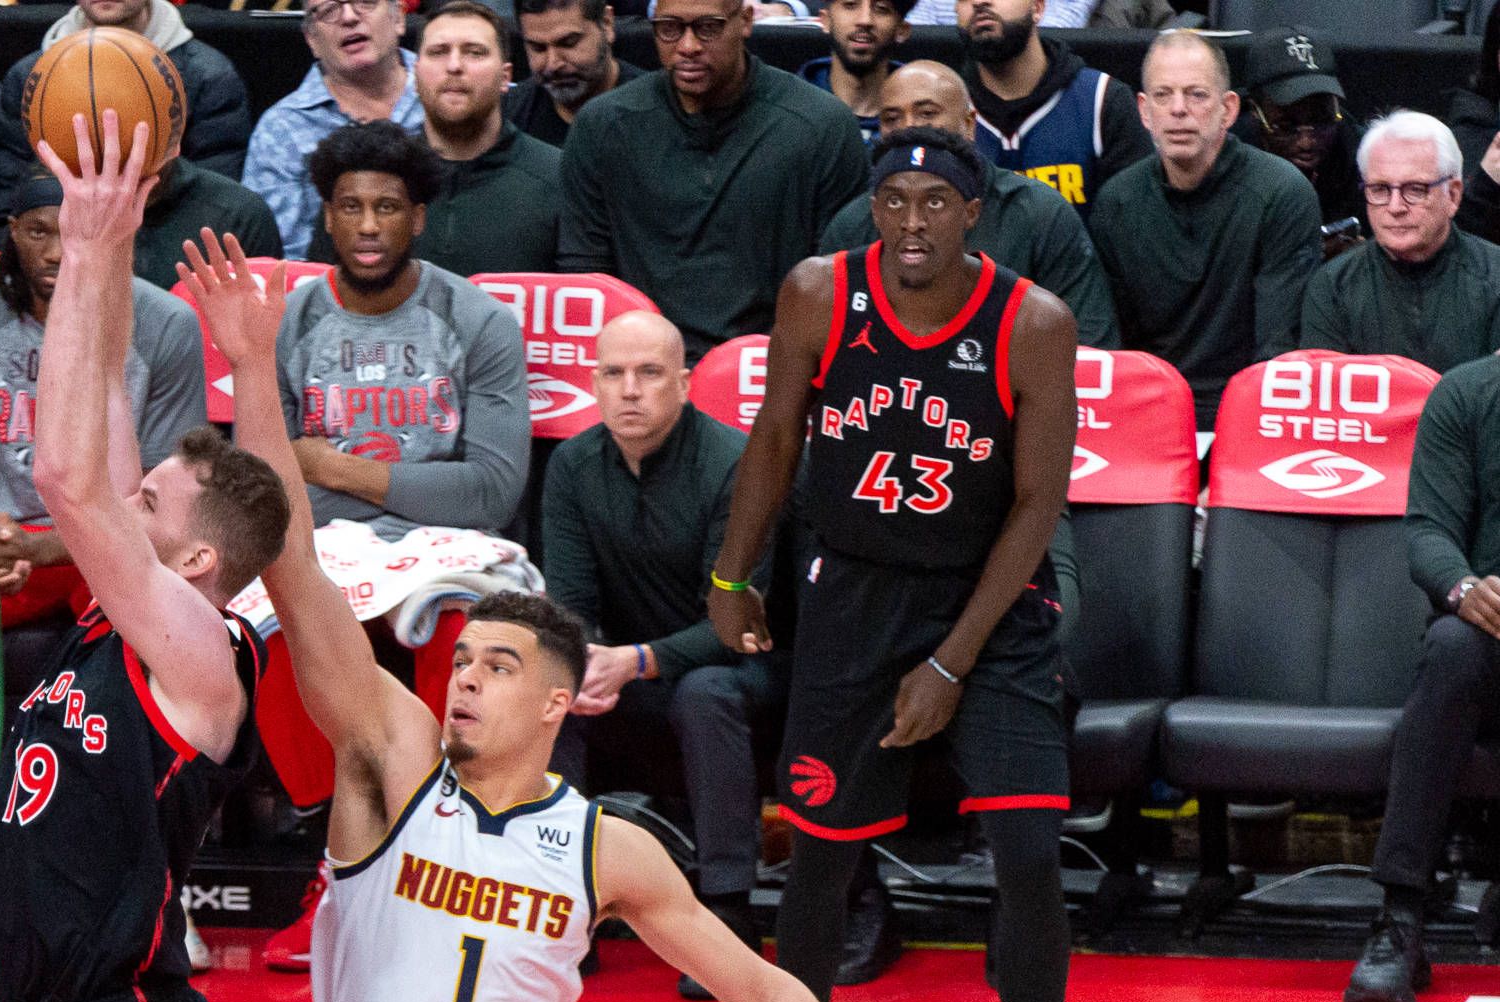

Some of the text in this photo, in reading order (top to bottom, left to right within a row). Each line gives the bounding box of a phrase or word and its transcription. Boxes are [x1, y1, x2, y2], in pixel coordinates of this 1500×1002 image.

[851, 291, 869, 312] 6
[355, 365, 386, 382] LOS
[526, 341, 599, 367] EEL
[303, 376, 460, 438] RAPTORS
[1261, 361, 1391, 414] BIO
[822, 377, 994, 461] RAPTORS
[1258, 414, 1389, 444] STEEL
[852, 451, 954, 514] 43
[536, 825, 571, 847] WU
[394, 852, 575, 940] NUGGETS
